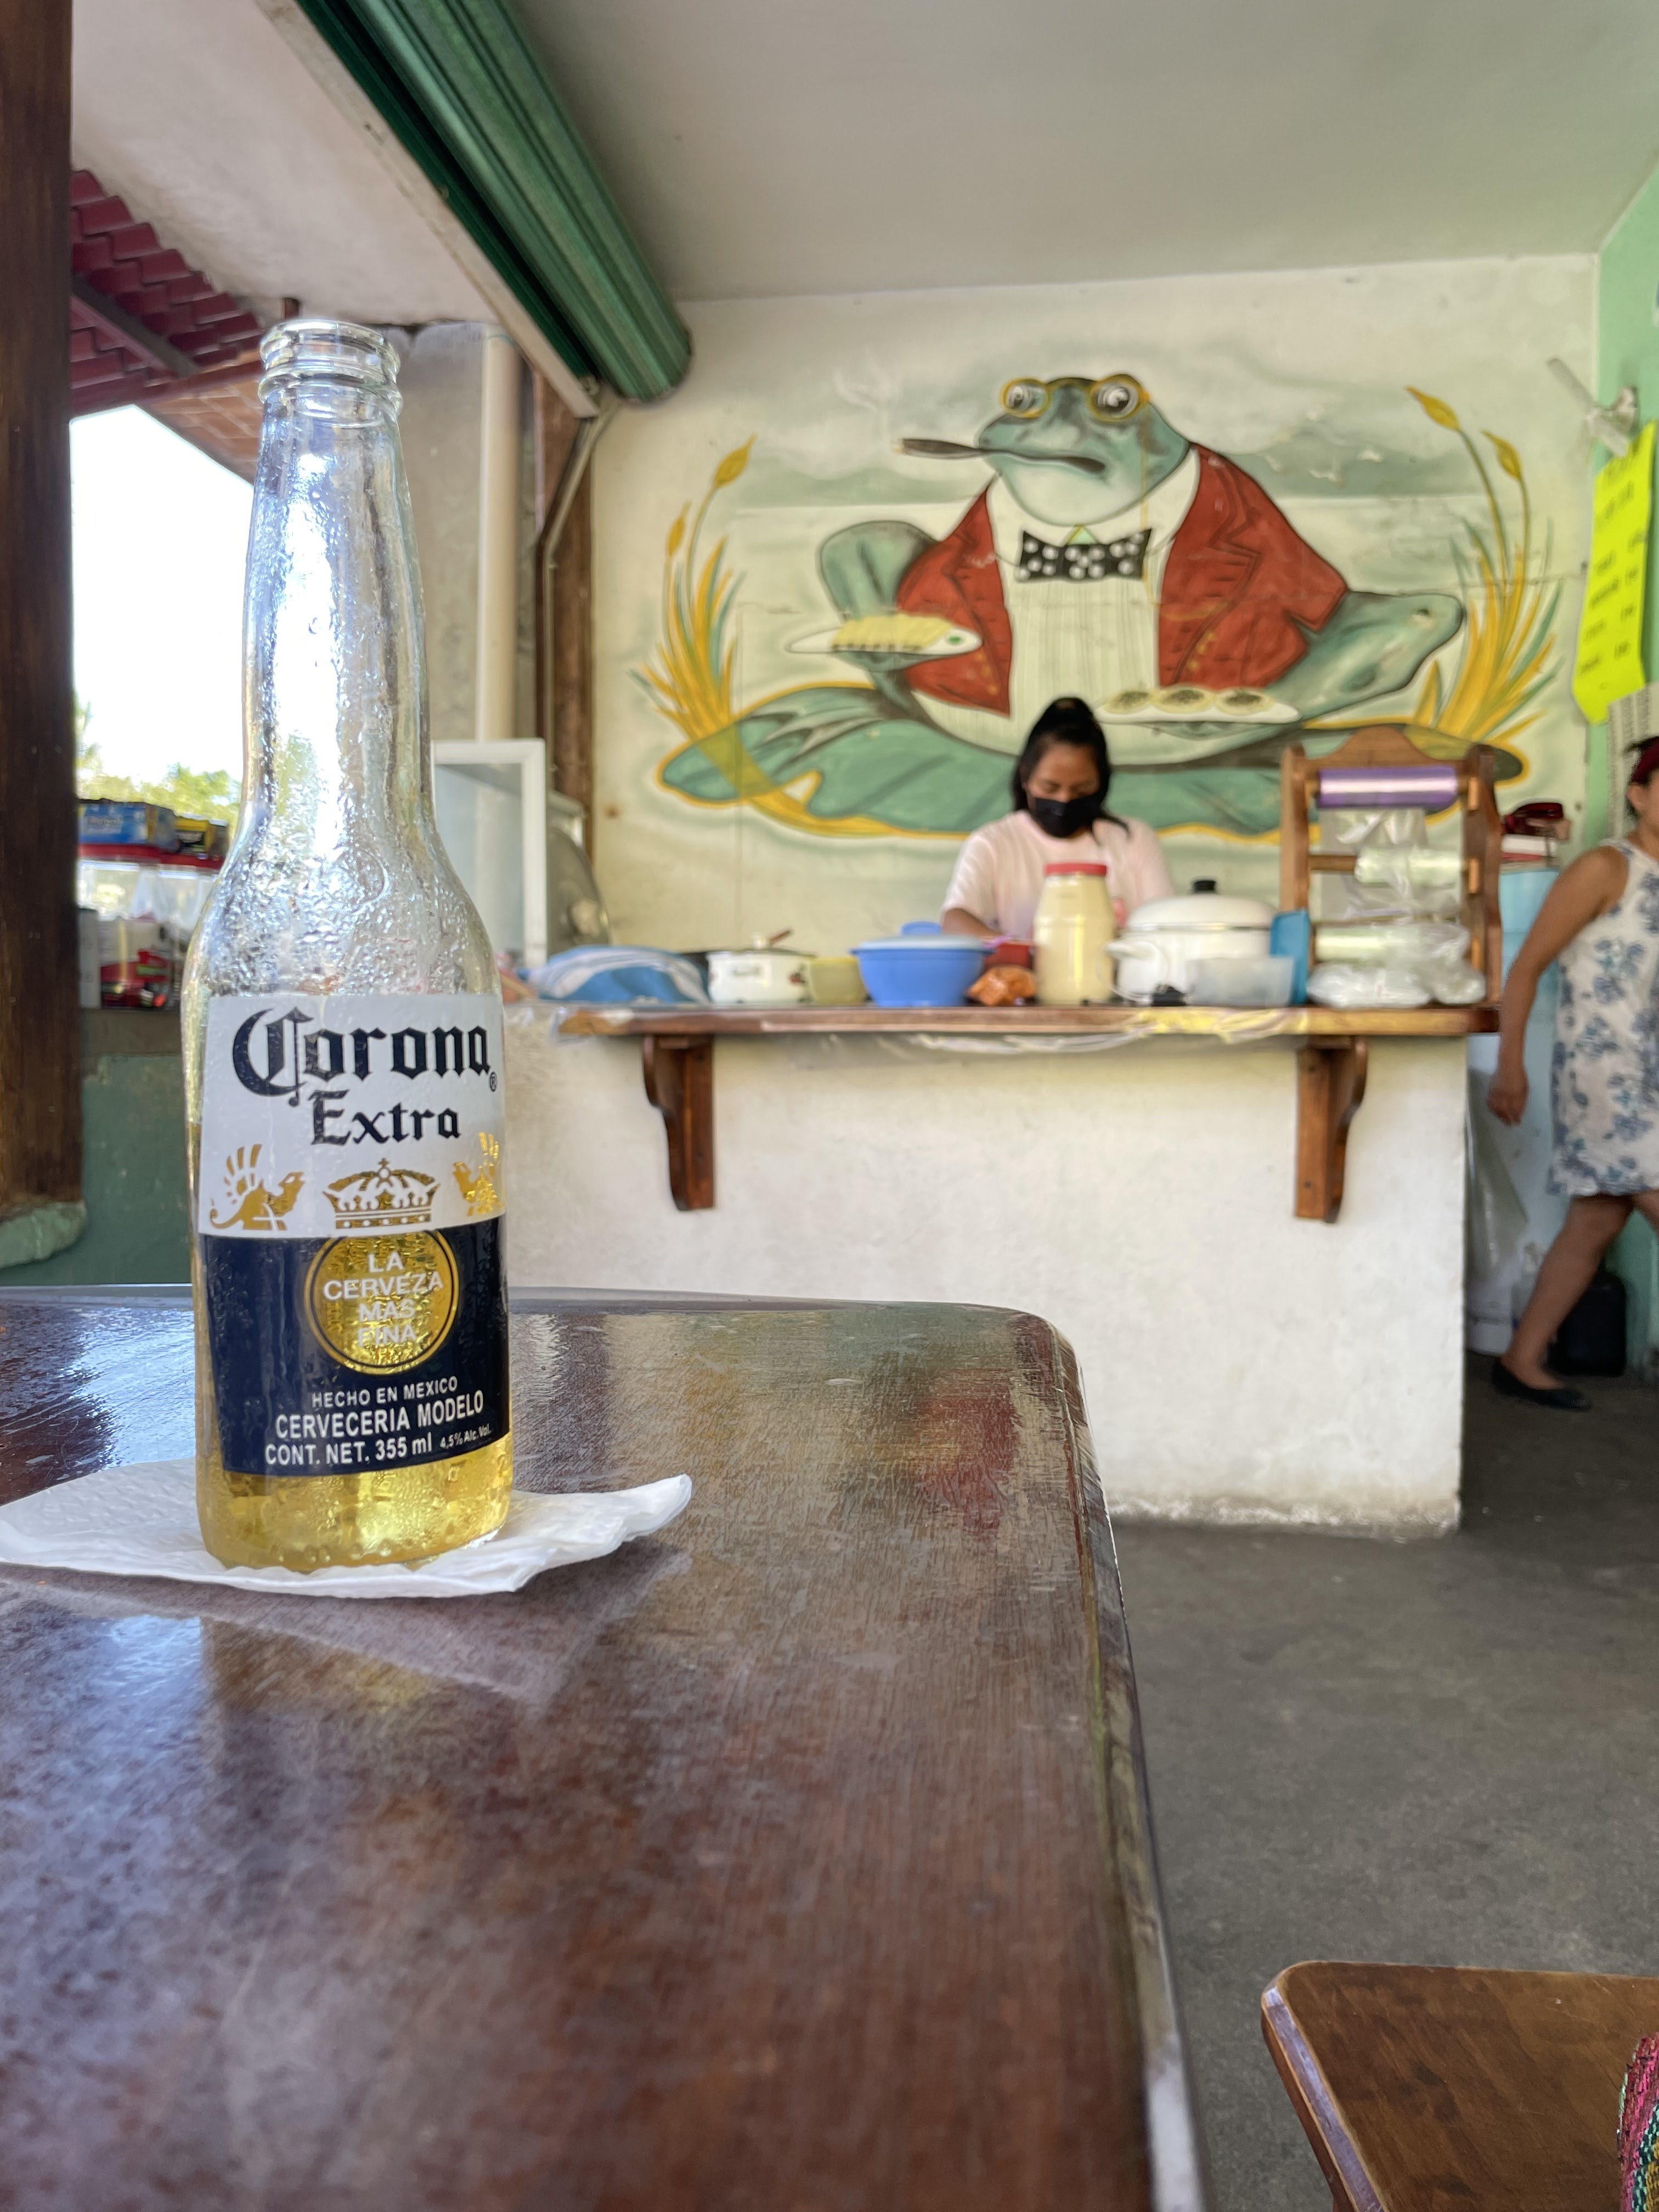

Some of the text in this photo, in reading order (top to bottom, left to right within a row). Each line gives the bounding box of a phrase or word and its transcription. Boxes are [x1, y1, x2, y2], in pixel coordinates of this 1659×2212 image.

[232, 1006, 490, 1107] Corona
[308, 1088, 460, 1146] Extra
[367, 1250, 404, 1273] LA
[323, 1271, 444, 1301] CERVEZA
[359, 1299, 416, 1323] MAS
[358, 1324, 417, 1347] FINA
[312, 1376, 458, 1408] HECHO EN MEXICO
[275, 1390, 483, 1439] CERVECERIA MODELO
[265, 1443, 321, 1465] CONT.
[326, 1441, 370, 1465] NET.
[375, 1437, 407, 1460] 355
[411, 1432, 432, 1455] ml
